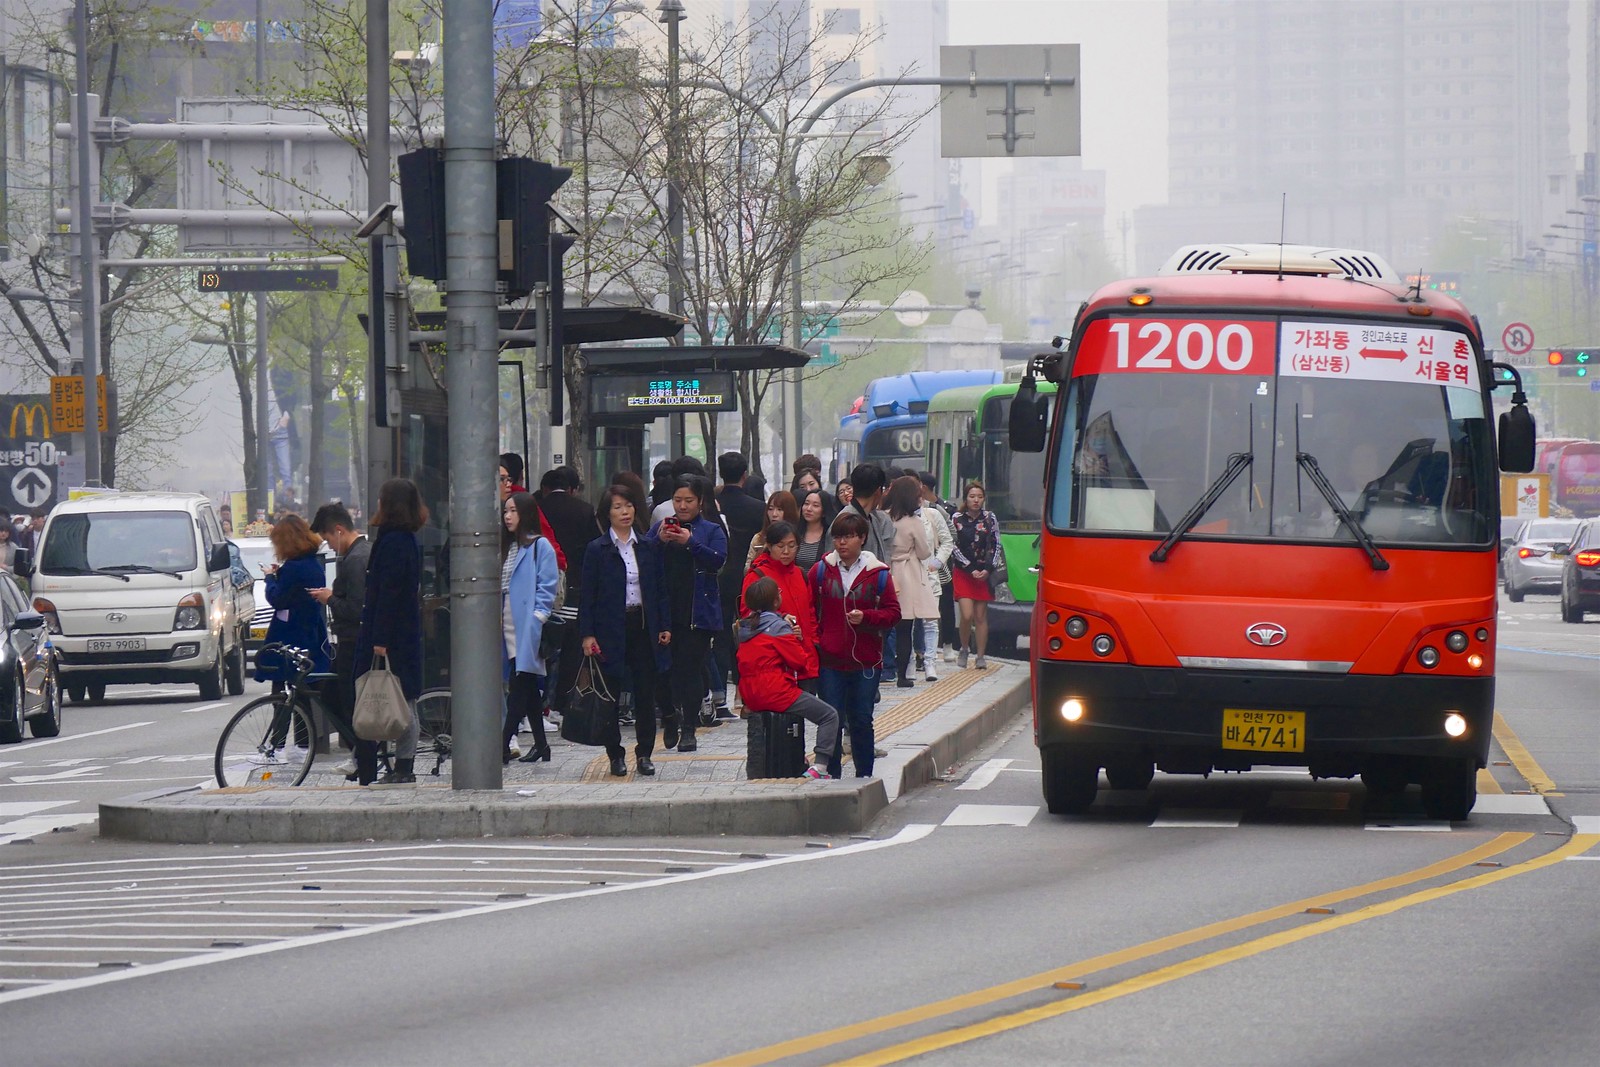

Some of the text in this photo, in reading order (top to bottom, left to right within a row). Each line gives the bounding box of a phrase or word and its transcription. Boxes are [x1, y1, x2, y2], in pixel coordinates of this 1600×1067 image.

[1108, 322, 1254, 371] 1200
[1294, 329, 1350, 350] 가좌동
[1361, 330, 1408, 344] 경인고속도로
[1292, 353, 1350, 374] (삼산동)
[1415, 359, 1469, 385] 서울역
[648, 380, 700, 389] 도로명 주소를
[675, 388, 700, 397] 합시다
[54, 406, 104, 428] 무인단중
[93, 640, 141, 651] 89구 9903
[1267, 713, 1285, 724] 70
[1226, 726, 1297, 749] 바4741
